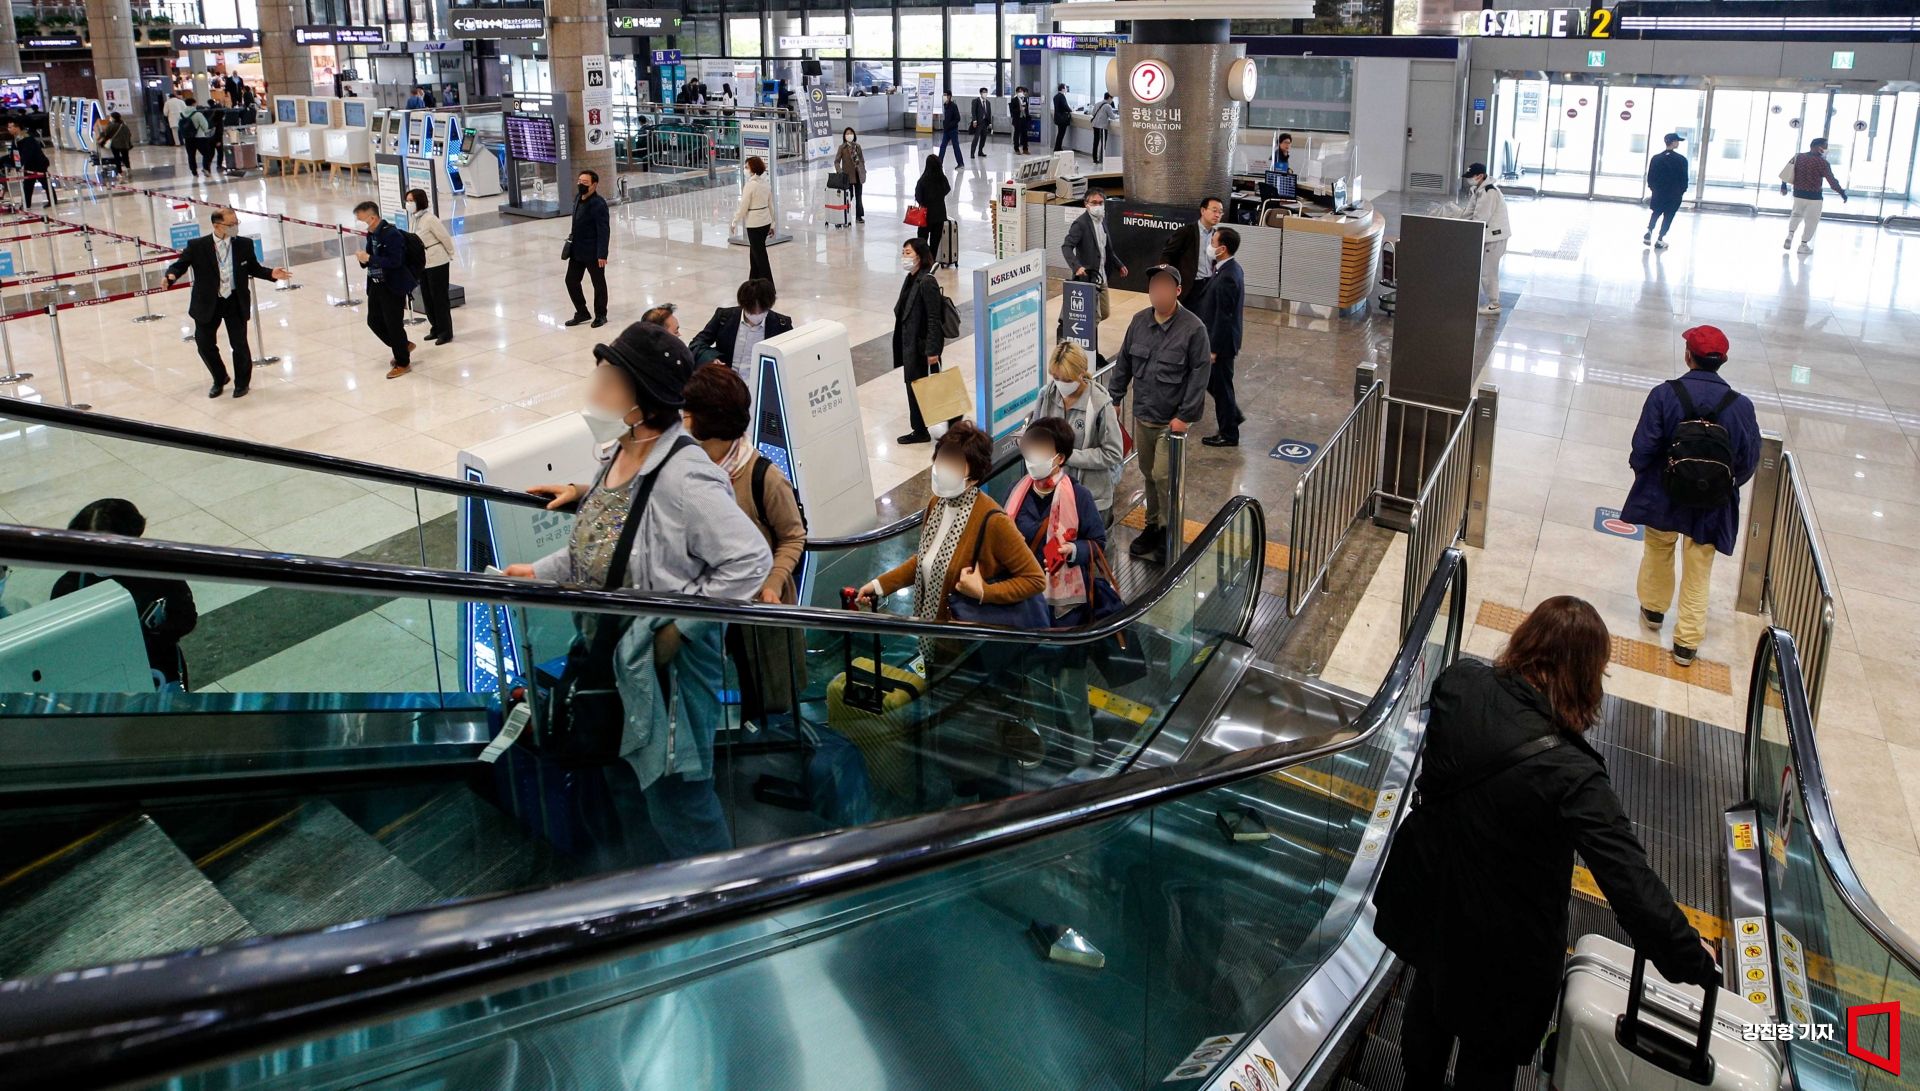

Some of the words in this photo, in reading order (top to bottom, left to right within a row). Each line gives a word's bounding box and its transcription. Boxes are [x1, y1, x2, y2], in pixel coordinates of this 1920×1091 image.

[1479, 9, 1568, 37] GATE
[1591, 9, 1613, 38] 2
[1131, 107, 1152, 121] 공항
[1155, 108, 1181, 122] 안내
[1132, 122, 1181, 131] INFORMATION
[559, 123, 567, 160] SAMSUNG
[1149, 145, 1160, 153] 2F
[991, 268, 1018, 286] KOREAN
[1018, 264, 1032, 276] AIR
[808, 379, 841, 407] KAC
[811, 397, 843, 418] 한국공항공사
